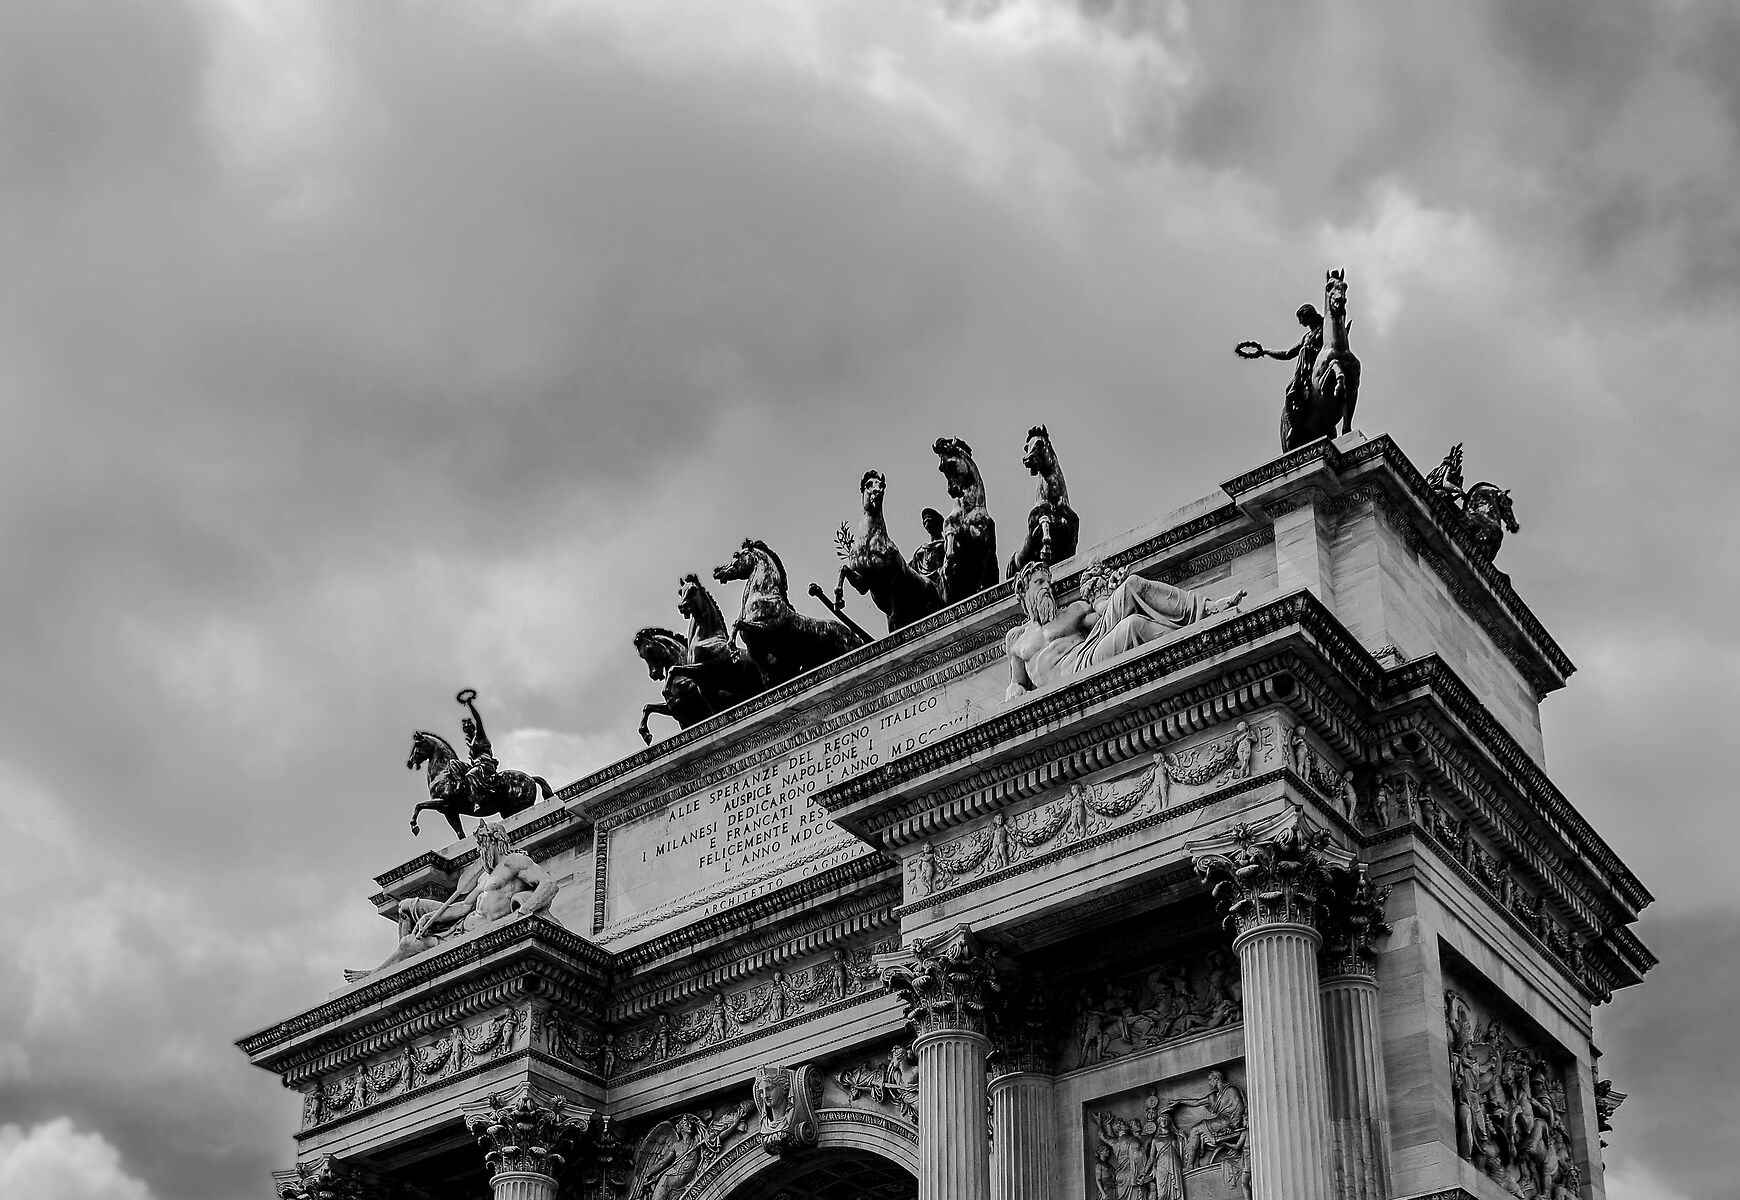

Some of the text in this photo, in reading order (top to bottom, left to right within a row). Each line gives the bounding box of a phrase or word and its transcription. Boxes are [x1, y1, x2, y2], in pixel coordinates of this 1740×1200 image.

[669, 697, 937, 822] ALLE SPERANZE DEL REGNO ITALICO
[723, 739, 873, 813] AUSPICE NAPOLEONE I
[655, 821, 717, 857] MILANESI
[727, 781, 815, 826] DEDICARONO
[841, 754, 879, 778] ANNO
[709, 797, 815, 849] E FRANCATI D
[699, 822, 789, 868] FELICEMENTE
[742, 841, 781, 866] ANNO
[790, 819, 834, 846] MDCC
[703, 846, 865, 916] ARCHITETTO CAGNOLA
